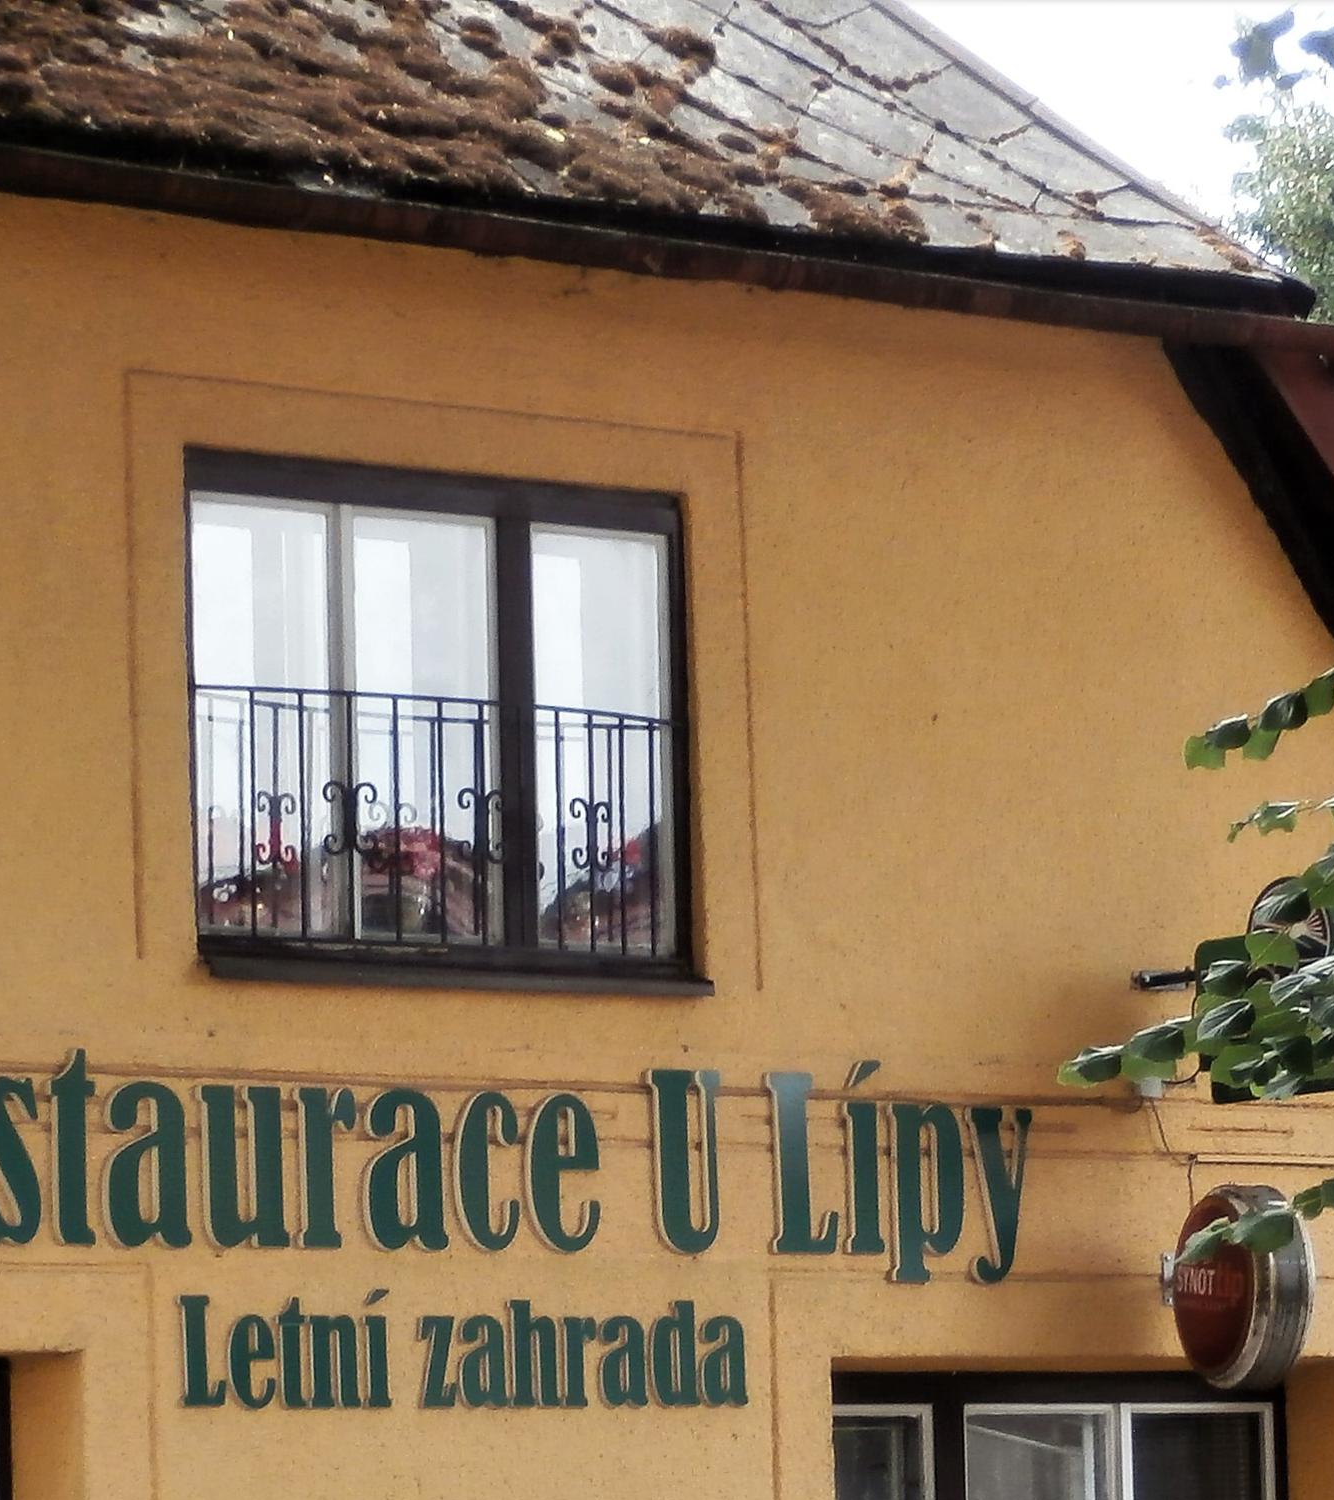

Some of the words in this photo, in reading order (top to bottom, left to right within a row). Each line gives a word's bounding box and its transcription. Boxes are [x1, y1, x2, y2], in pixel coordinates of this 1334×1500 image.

[644, 1068, 720, 1254] U
[763, 1060, 1033, 1284] Lípy
[1177, 1265, 1216, 1296] SYNOT
[175, 1288, 393, 1409] Letní
[418, 1299, 749, 1409] zahrada
